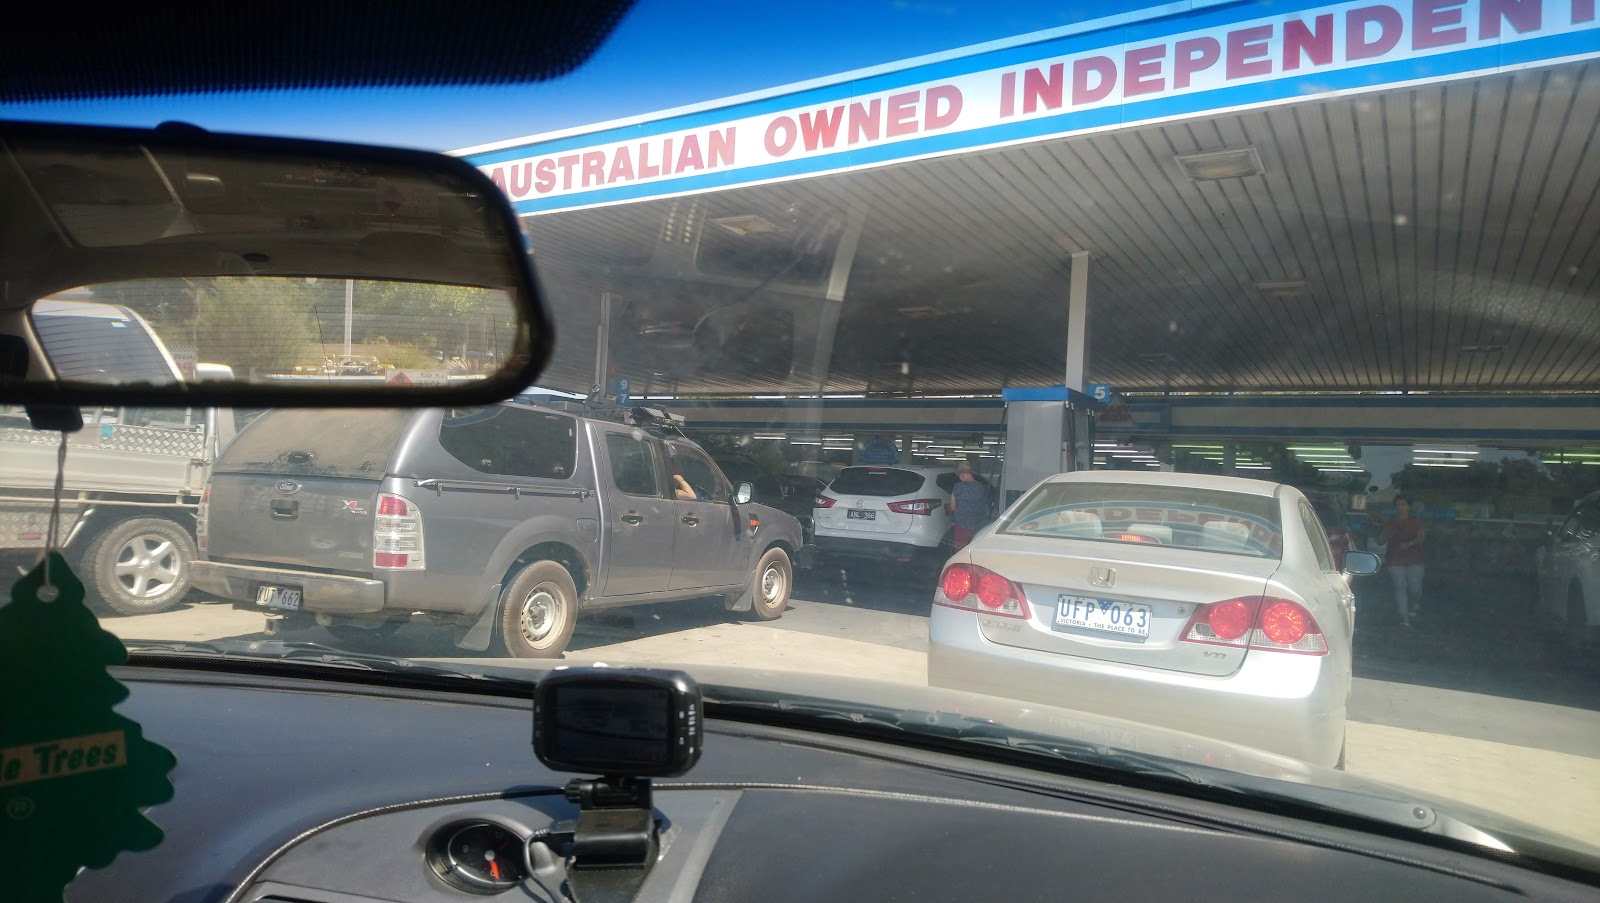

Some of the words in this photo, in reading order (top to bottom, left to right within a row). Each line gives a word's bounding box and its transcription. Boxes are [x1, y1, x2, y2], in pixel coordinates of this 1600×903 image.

[764, 84, 964, 157] OWNED
[620, 379, 628, 390] 9
[620, 393, 628, 404] 7
[1094, 386, 1106, 400] 5
[281, 591, 300, 607] 662
[1060, 598, 1096, 621] UFP
[1110, 604, 1147, 628] 063
[1060, 618, 1086, 626] VICTORIA
[1107, 624, 1125, 632] PLACE
[32, 743, 118, 776] Trees
